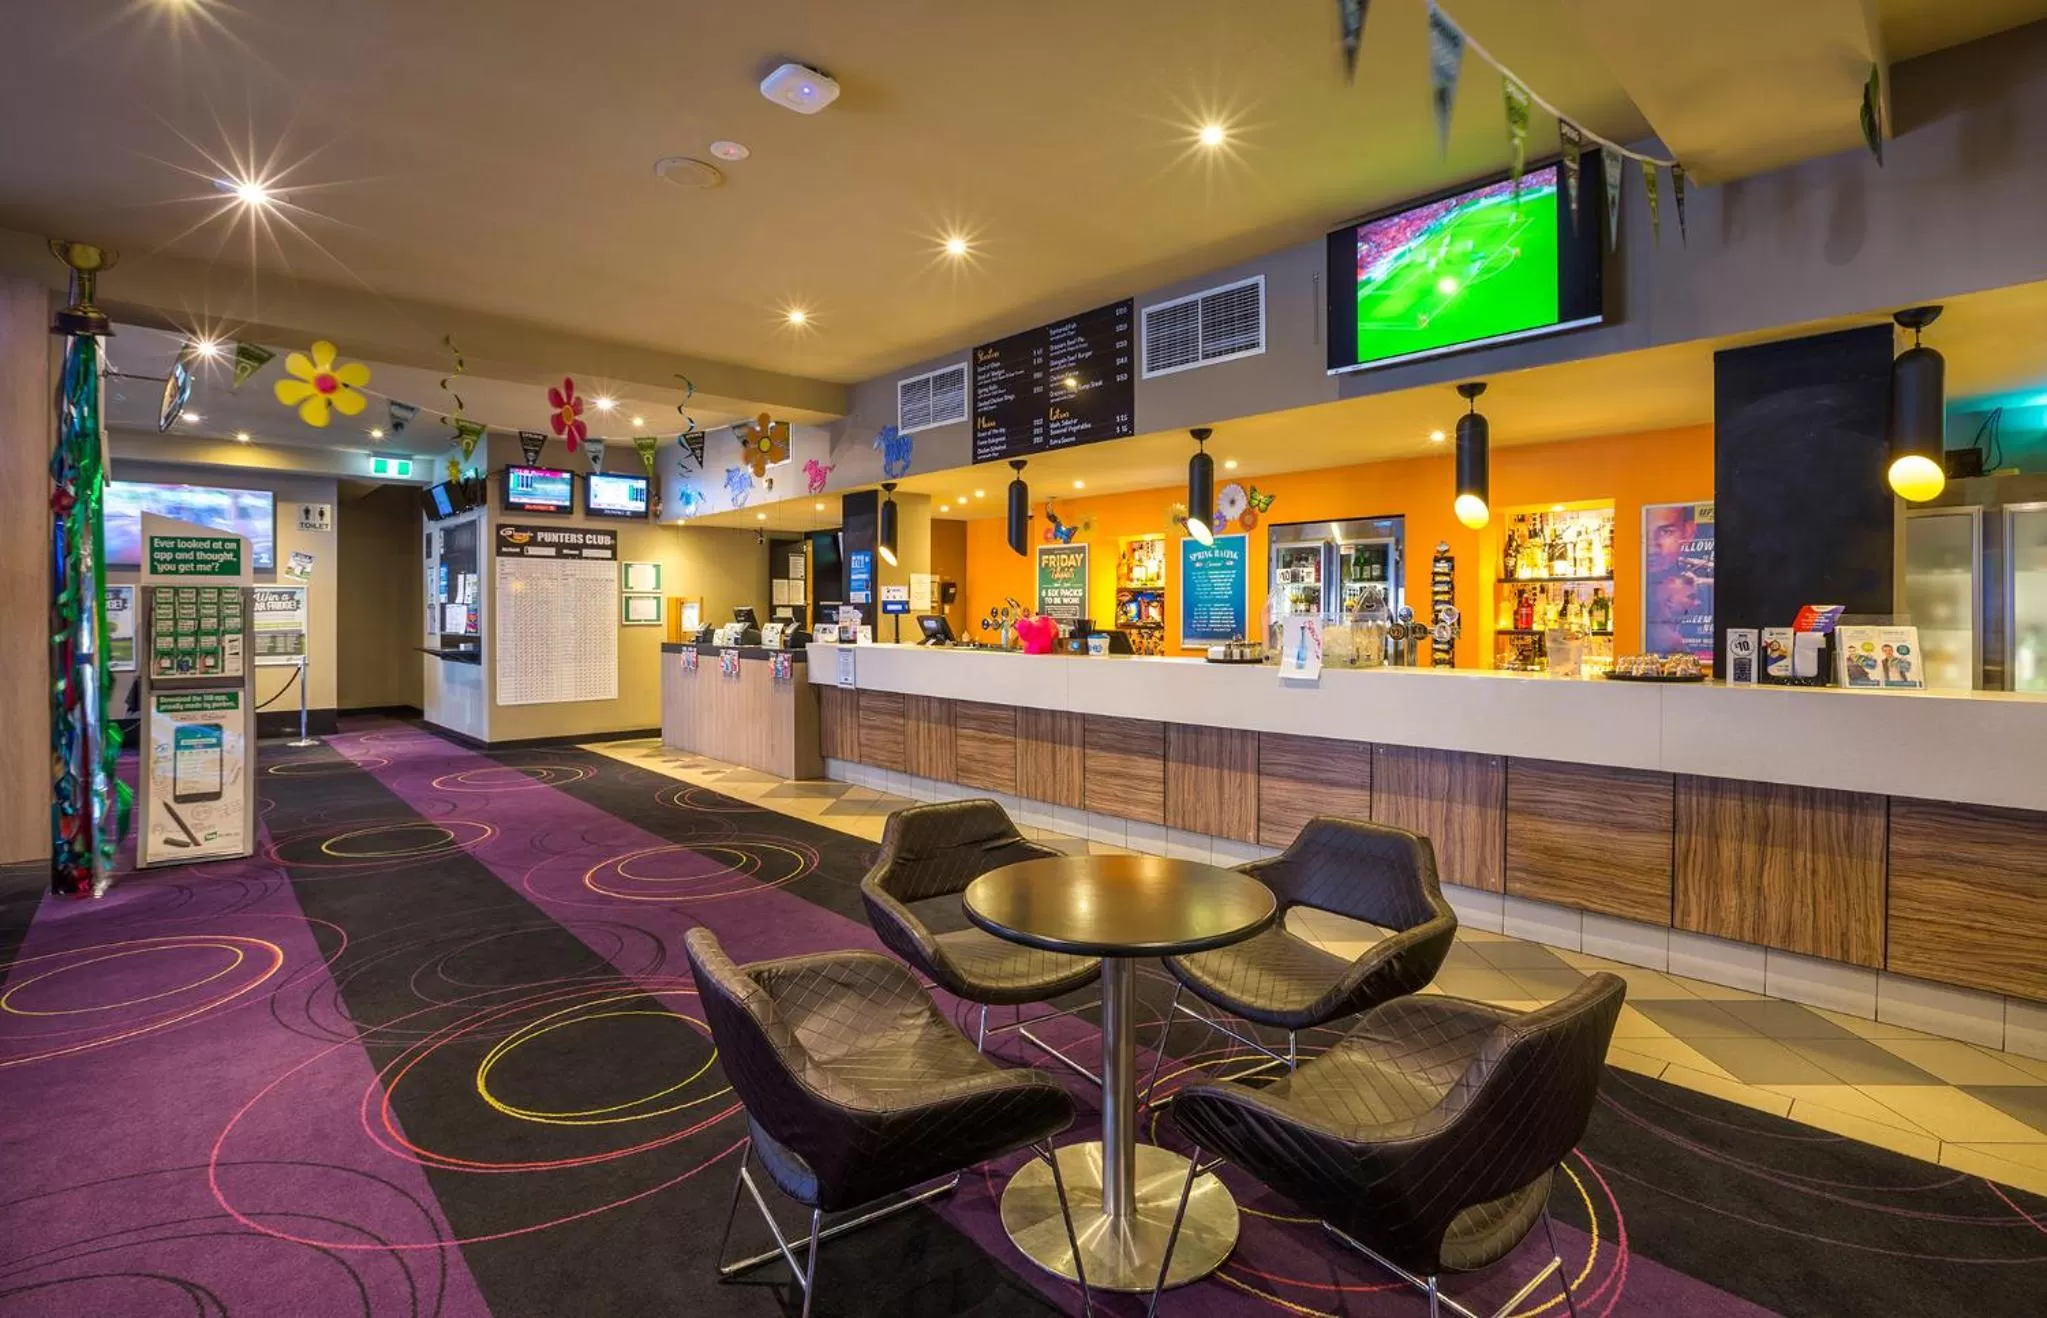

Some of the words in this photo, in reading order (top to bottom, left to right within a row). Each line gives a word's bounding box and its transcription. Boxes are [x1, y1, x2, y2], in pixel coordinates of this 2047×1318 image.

[300, 521, 330, 529] TOILET
[153, 538, 174, 548] Ever
[177, 539, 210, 549] looked
[212, 540, 223, 549] at
[224, 542, 237, 550] an
[537, 531, 584, 544] PUNTERS
[585, 534, 611, 545] CLUB
[153, 551, 173, 561] app
[175, 551, 194, 559] and
[1041, 553, 1084, 568] FRIDAY
[1189, 551, 1214, 561] SPRING
[178, 562, 195, 574] get
